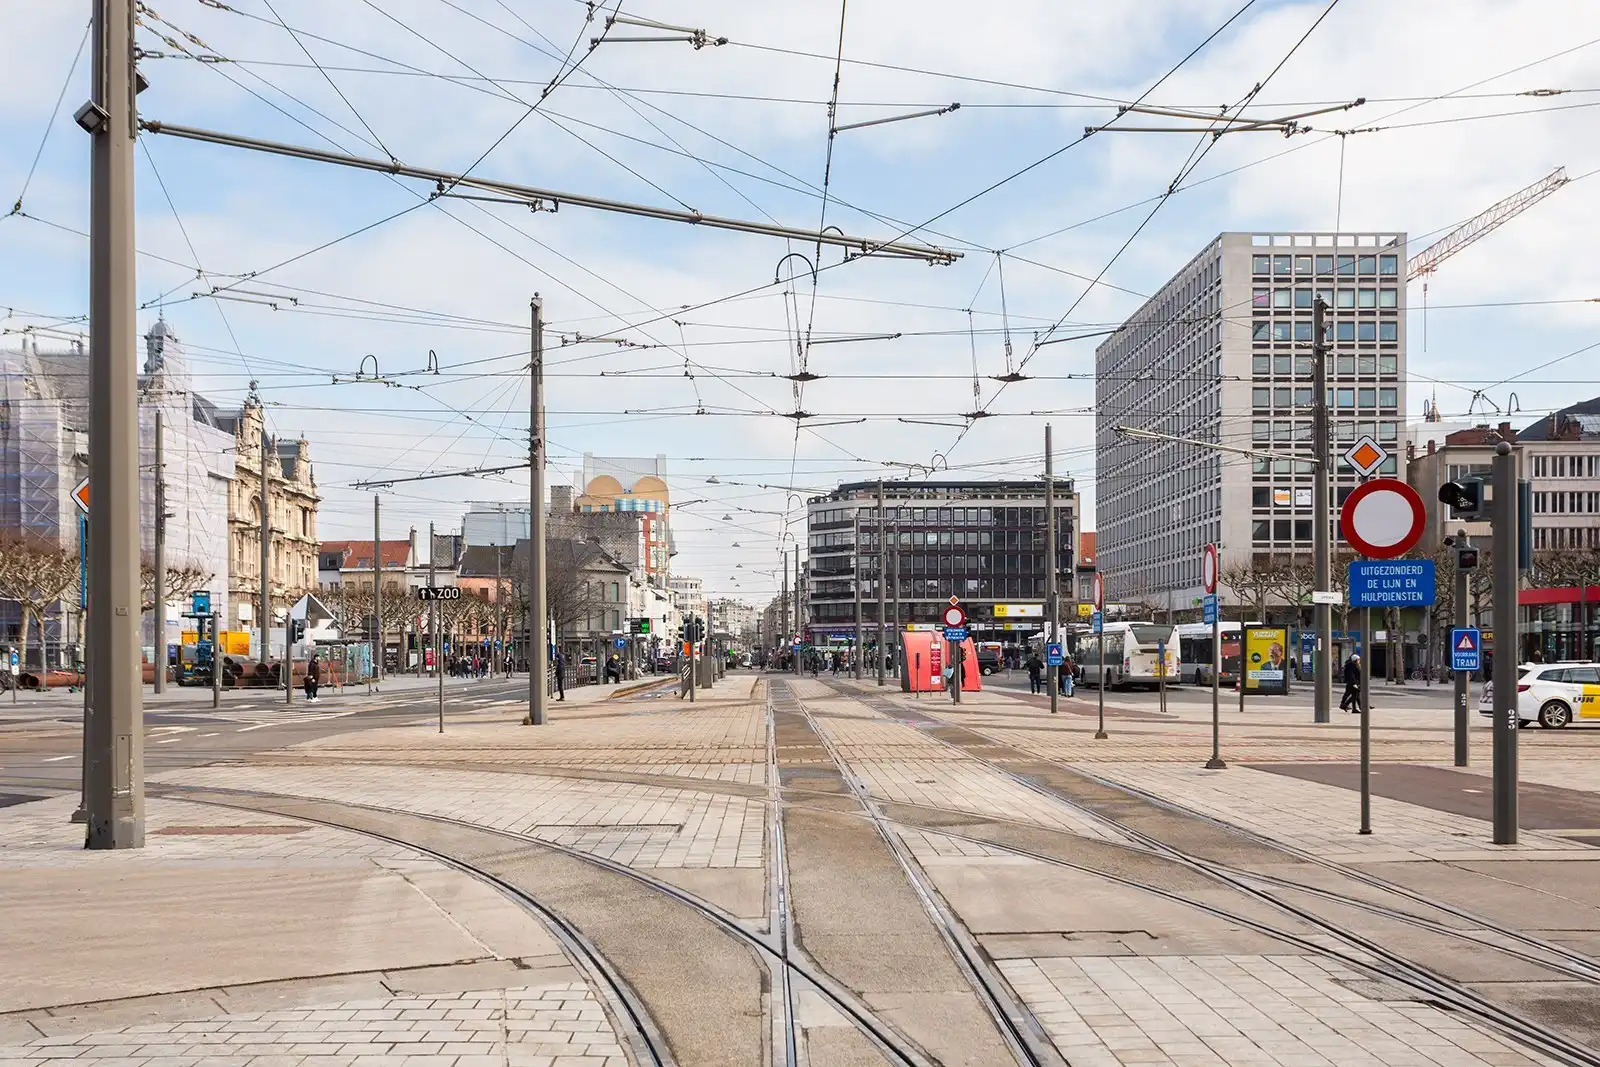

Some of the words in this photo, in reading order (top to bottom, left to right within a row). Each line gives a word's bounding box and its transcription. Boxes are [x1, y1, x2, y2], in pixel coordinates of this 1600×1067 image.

[1361, 565, 1423, 576] UITGEZONDERD
[1367, 579, 1378, 588] DE
[1382, 578, 1401, 588] LIJN
[1405, 578, 1416, 588] EN
[437, 588, 459, 599] ZOO
[1361, 591, 1423, 602] HULPDIENSTEN
[1456, 658, 1476, 667] TRAM
